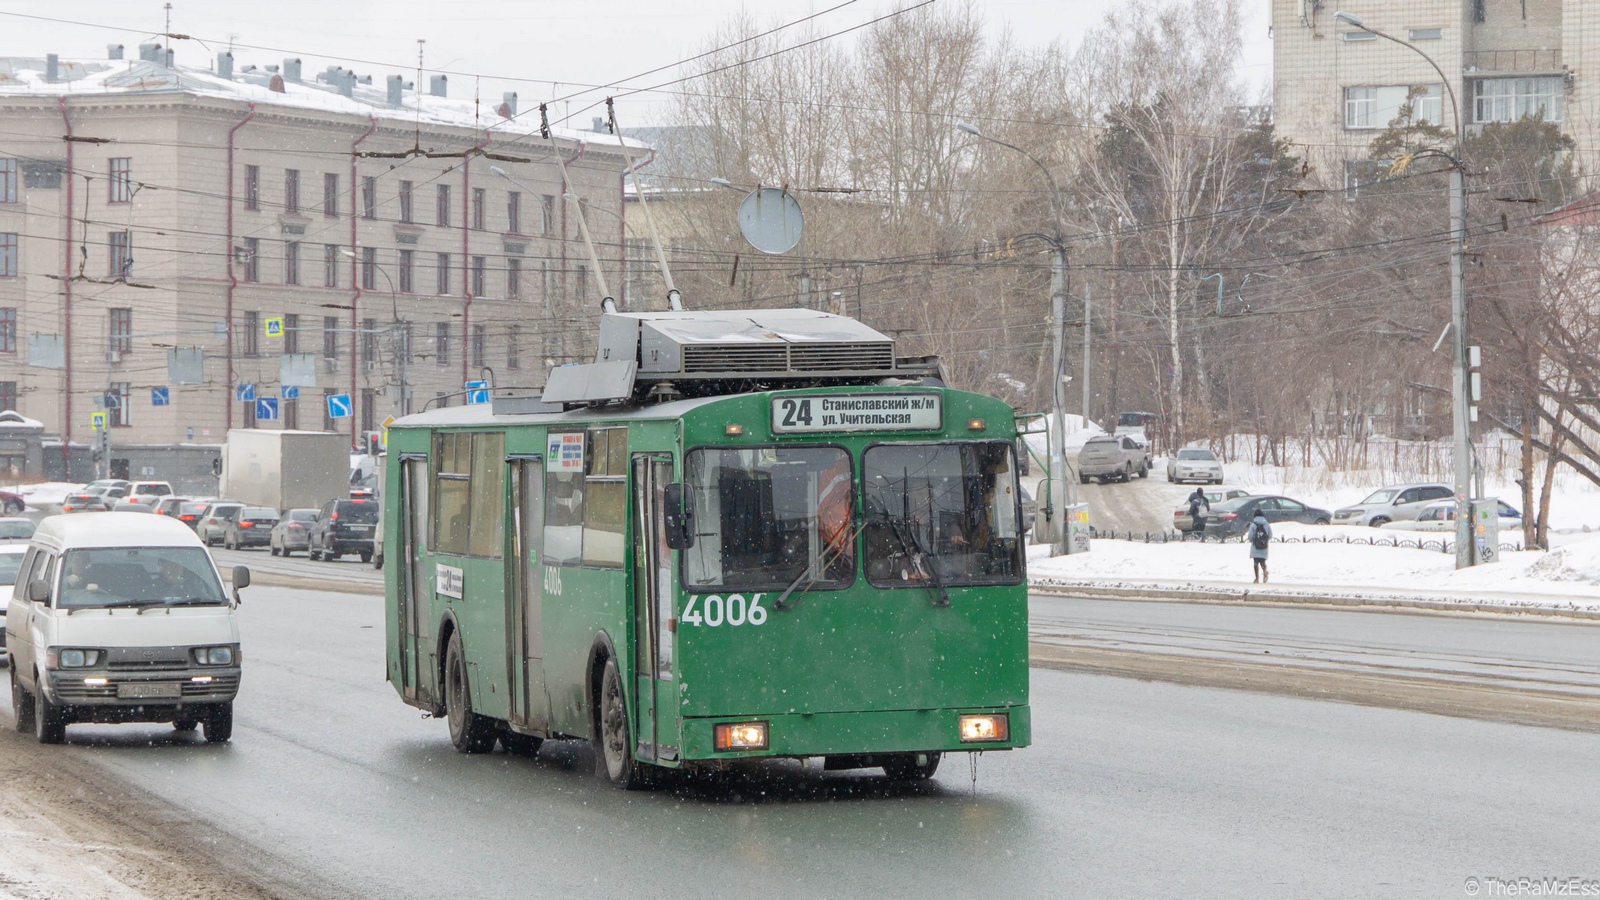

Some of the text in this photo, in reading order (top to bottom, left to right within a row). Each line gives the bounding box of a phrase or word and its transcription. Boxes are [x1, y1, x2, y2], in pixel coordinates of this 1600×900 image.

[782, 399, 813, 427] 24
[822, 397, 935, 411] Станиславский ж/м
[822, 412, 911, 427] ул. Учительская
[544, 566, 562, 596] 4006
[682, 593, 767, 627] 4006
